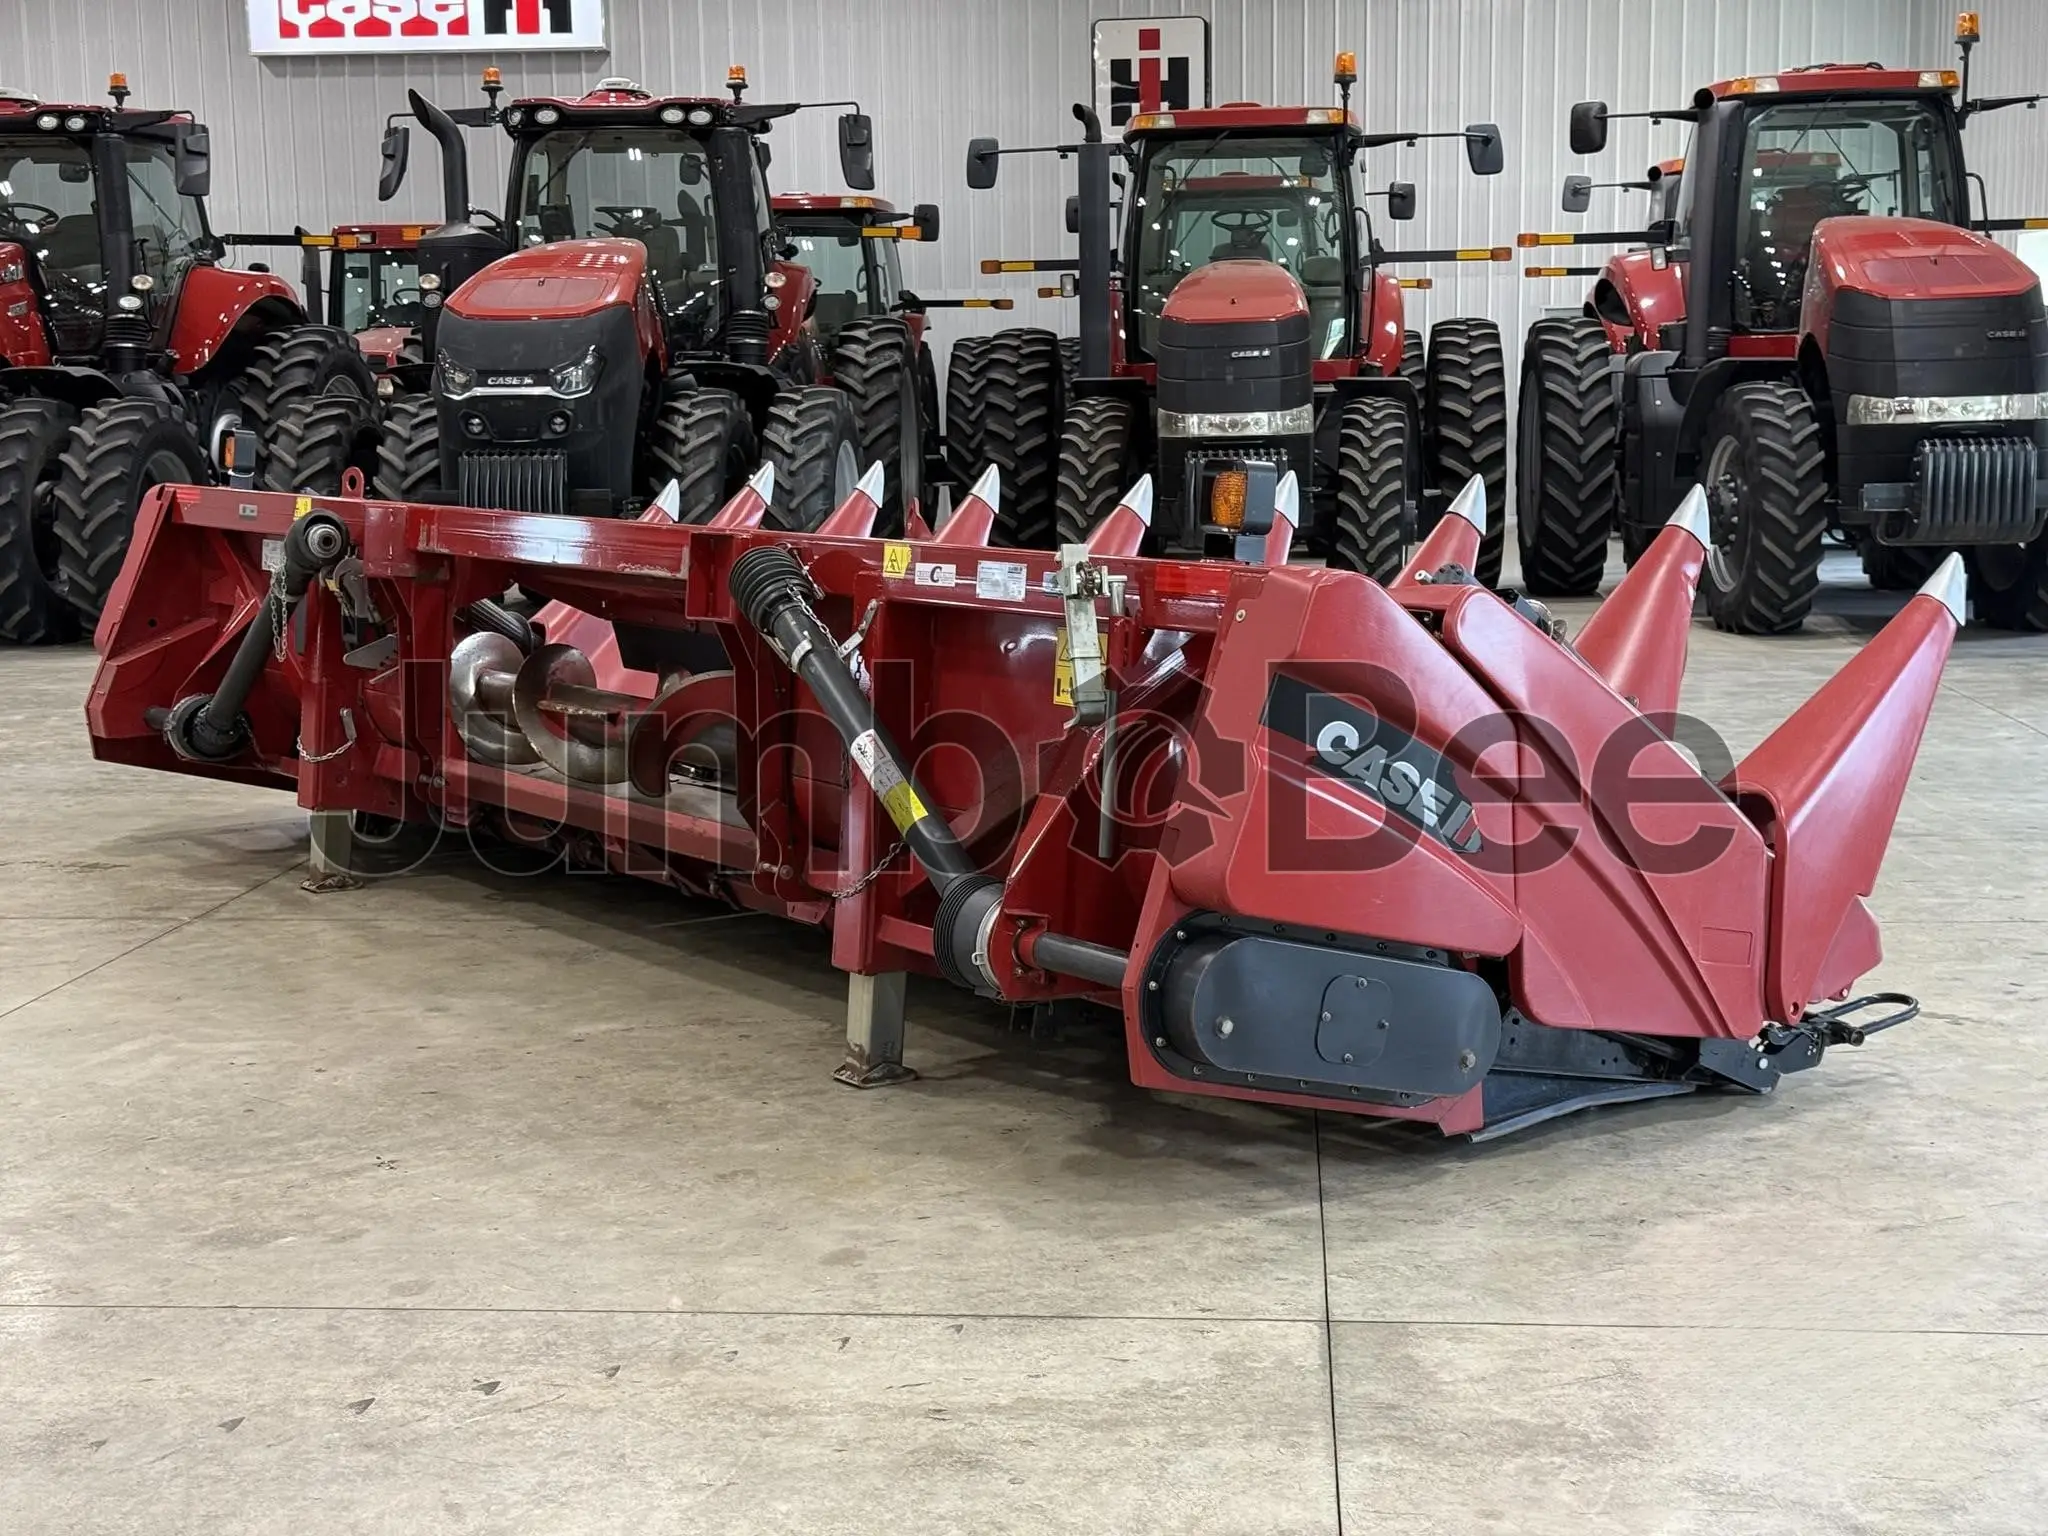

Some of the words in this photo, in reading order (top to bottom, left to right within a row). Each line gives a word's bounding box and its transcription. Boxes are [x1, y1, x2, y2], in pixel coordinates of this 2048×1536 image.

[1231, 350, 1260, 358] CASE
[487, 375, 521, 385] CASE
[1316, 720, 1455, 828] CASE
